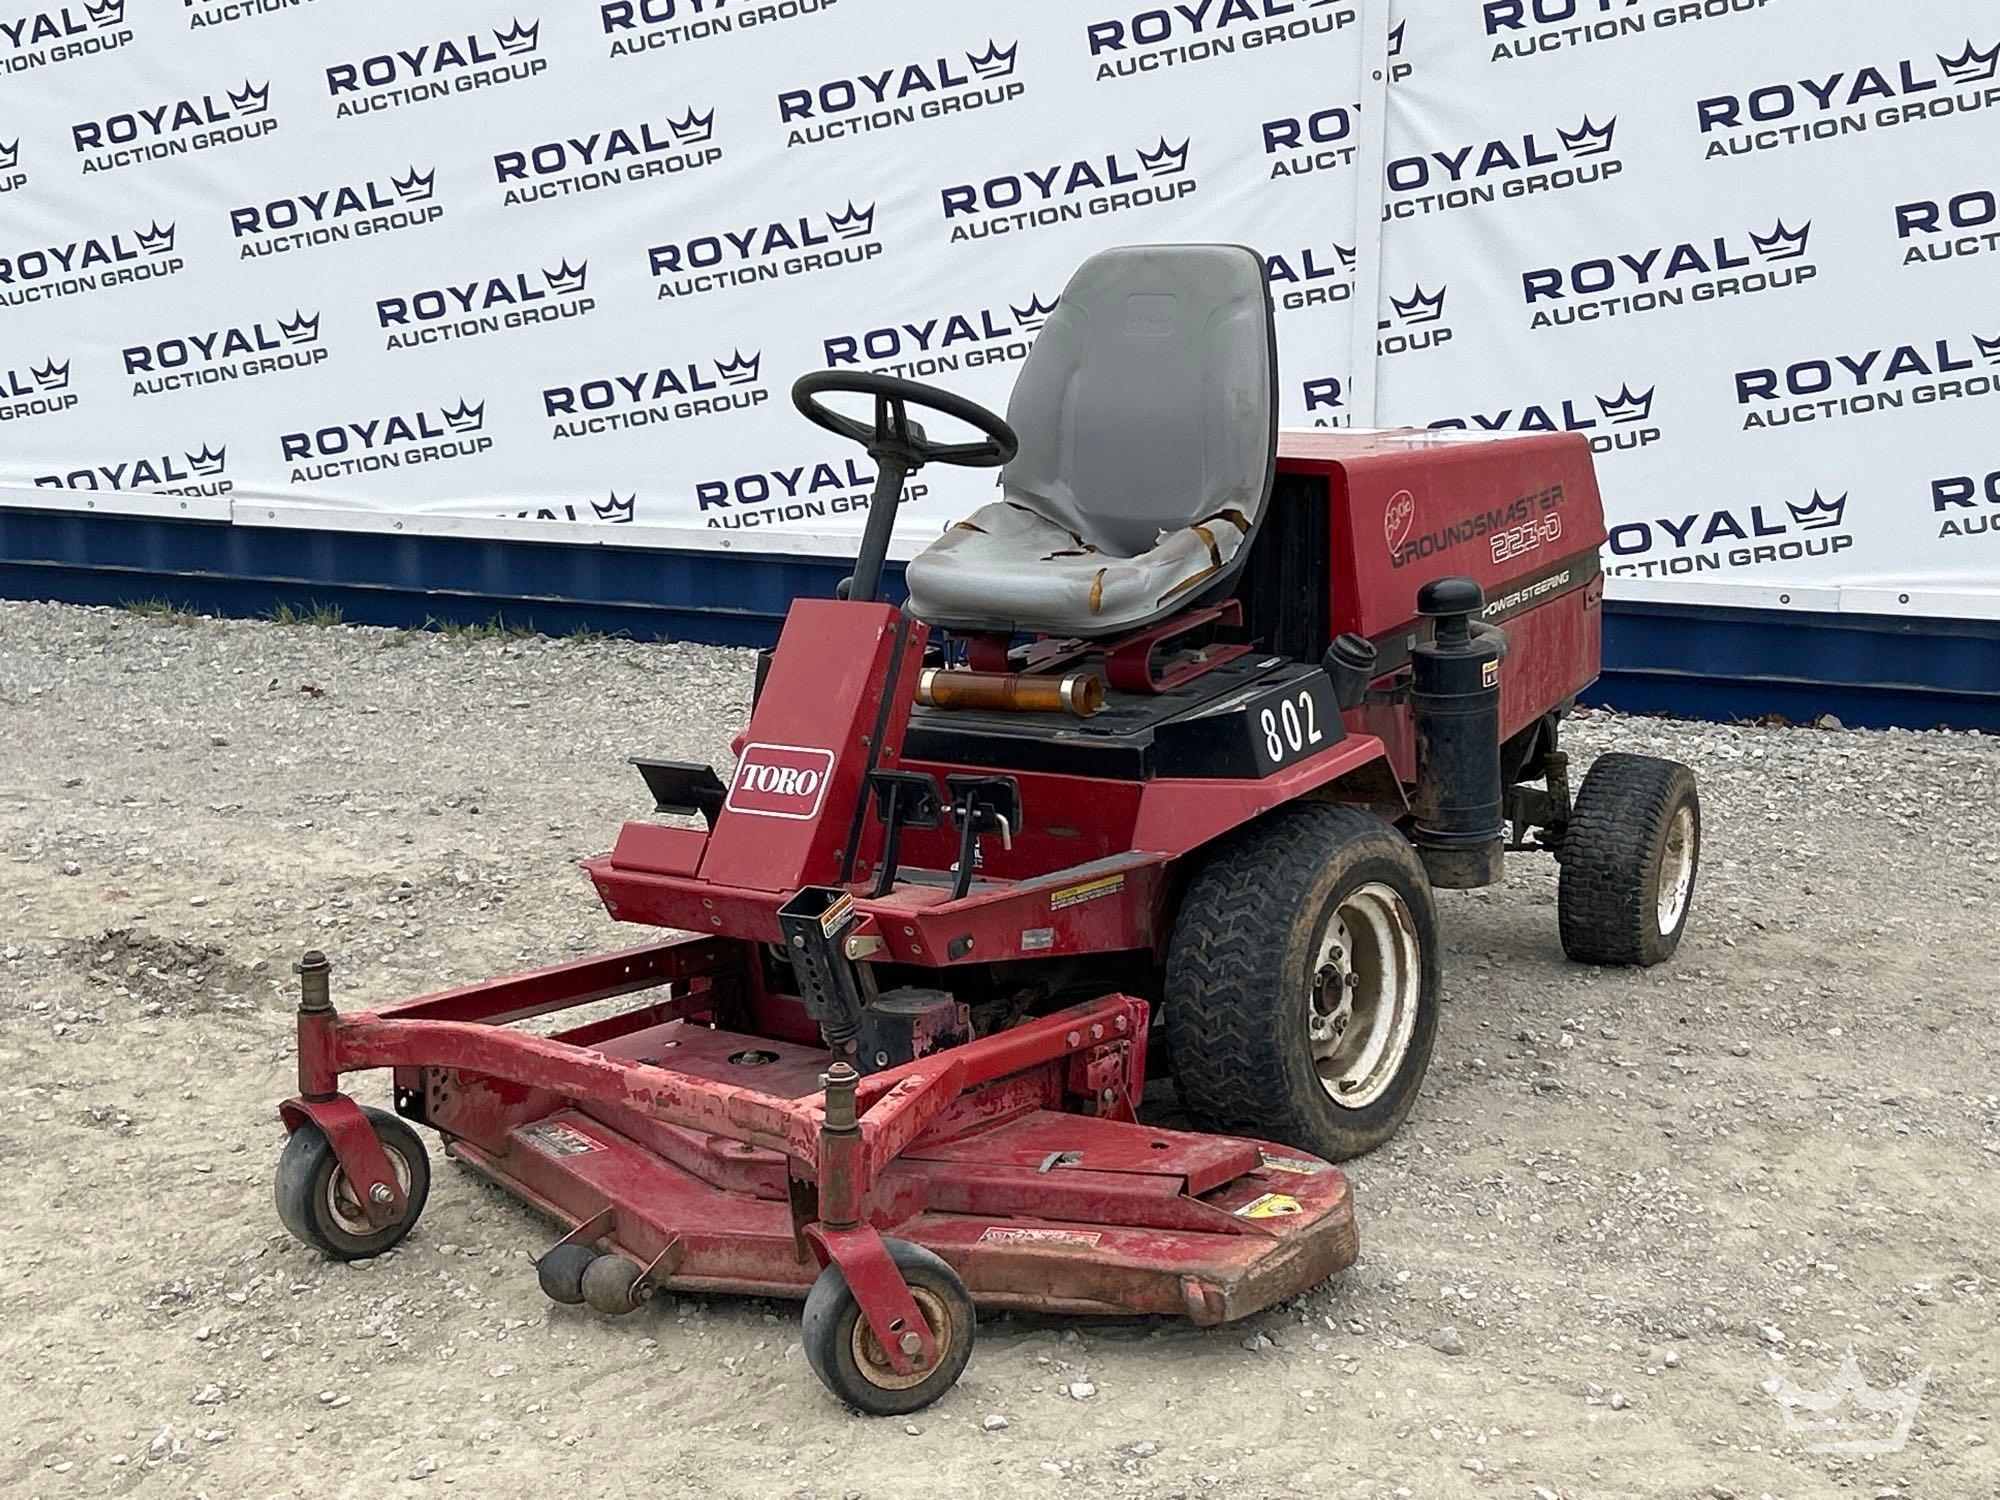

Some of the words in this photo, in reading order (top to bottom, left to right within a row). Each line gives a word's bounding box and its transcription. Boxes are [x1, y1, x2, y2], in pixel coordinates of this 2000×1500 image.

[51, 30, 133, 62] GROUP
[610, 16, 732, 58] AUCTION
[1087, 0, 1294, 56] ROYAL
[1096, 36, 1234, 81] AUCTION
[1242, 10, 1355, 49] GROUP
[1491, 14, 1645, 62] AUCTION
[326, 35, 496, 95] ROYAL
[337, 80, 449, 118] AUCTION
[455, 59, 546, 92] GROUP
[778, 58, 968, 123] ROYAL
[788, 106, 914, 147] AUCTION
[921, 82, 1024, 118] GROUP
[1697, 60, 1937, 133] ROYAL
[72, 96, 230, 152] ROYAL
[83, 138, 187, 174] AUCTION
[192, 119, 277, 149] GROUP
[1262, 103, 1361, 153] RO
[1705, 113, 1866, 160] AUCTION
[494, 124, 670, 183] ROYAL
[504, 169, 621, 206] AUCTION
[627, 148, 722, 180] GROUP
[1503, 160, 1622, 198] GROUP
[230, 182, 394, 237] ROYAL
[941, 155, 1138, 218] ROYAL
[951, 202, 1082, 243] AUCTION
[1089, 180, 1196, 215] GROUP
[241, 224, 349, 259] AUCTION
[355, 206, 443, 236] GROUP
[648, 218, 828, 276] ROYAL
[101, 259, 183, 287] GROUP
[658, 263, 778, 300] AUCTION
[784, 242, 882, 275] GROUP
[1283, 282, 1356, 309] GRO
[1523, 237, 1749, 303] ROYAL
[376, 274, 545, 328] ROYAL
[1531, 288, 1683, 329] AUCTION
[1692, 265, 1816, 301] GROUP
[123, 324, 280, 374] ROYAL
[387, 316, 499, 350] AUCTION
[504, 299, 595, 328] GROUP
[824, 310, 1012, 367] ROYAL
[133, 365, 238, 396] AUCTION
[243, 348, 328, 376] GROUP
[965, 343, 1033, 367] GRO
[1735, 340, 1973, 404] ROYAL
[0, 394, 78, 420] GROUP
[543, 364, 716, 417] ROYAL
[553, 407, 669, 439] AUCTION
[675, 389, 768, 418] GROUP
[1743, 390, 1903, 430] AUCTION
[280, 412, 444, 461] ROYAL
[291, 453, 400, 483] AUCTION
[405, 437, 492, 464] GROUP
[696, 459, 874, 511] ROYAL
[1729, 535, 1852, 566] GROUP
[1481, 591, 1521, 619] POWER
[1521, 570, 1569, 602] STEERING
[1261, 691, 1322, 762] 802
[741, 764, 818, 796] TORO
